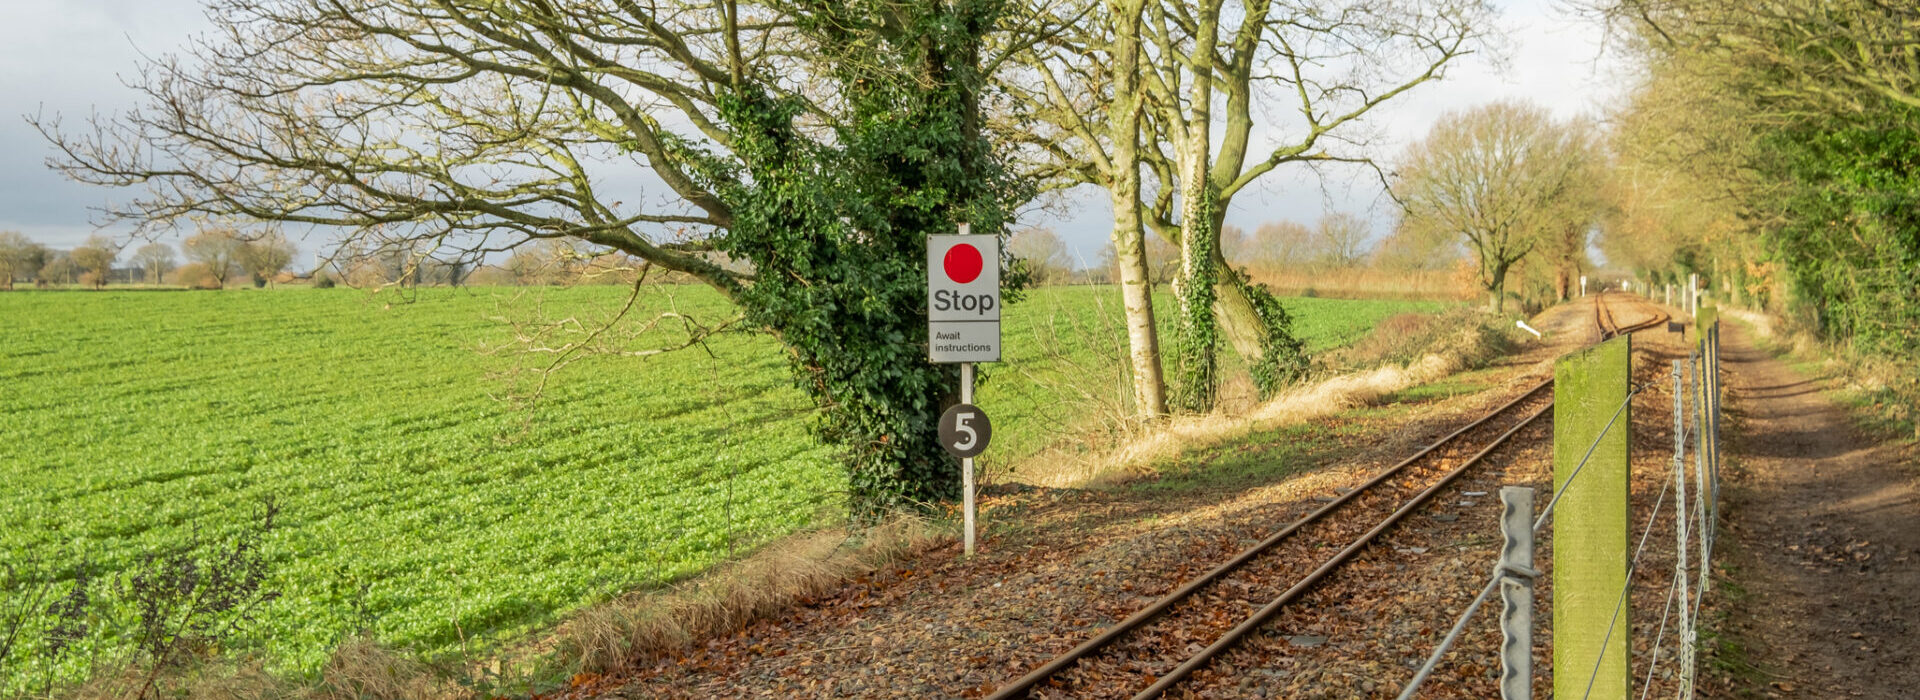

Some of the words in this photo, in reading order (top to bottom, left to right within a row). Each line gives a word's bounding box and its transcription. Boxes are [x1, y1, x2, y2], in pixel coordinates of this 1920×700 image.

[934, 289, 994, 315] Stop
[935, 331, 961, 340] Await
[935, 343, 991, 352] instructions
[953, 413, 977, 447] 5
